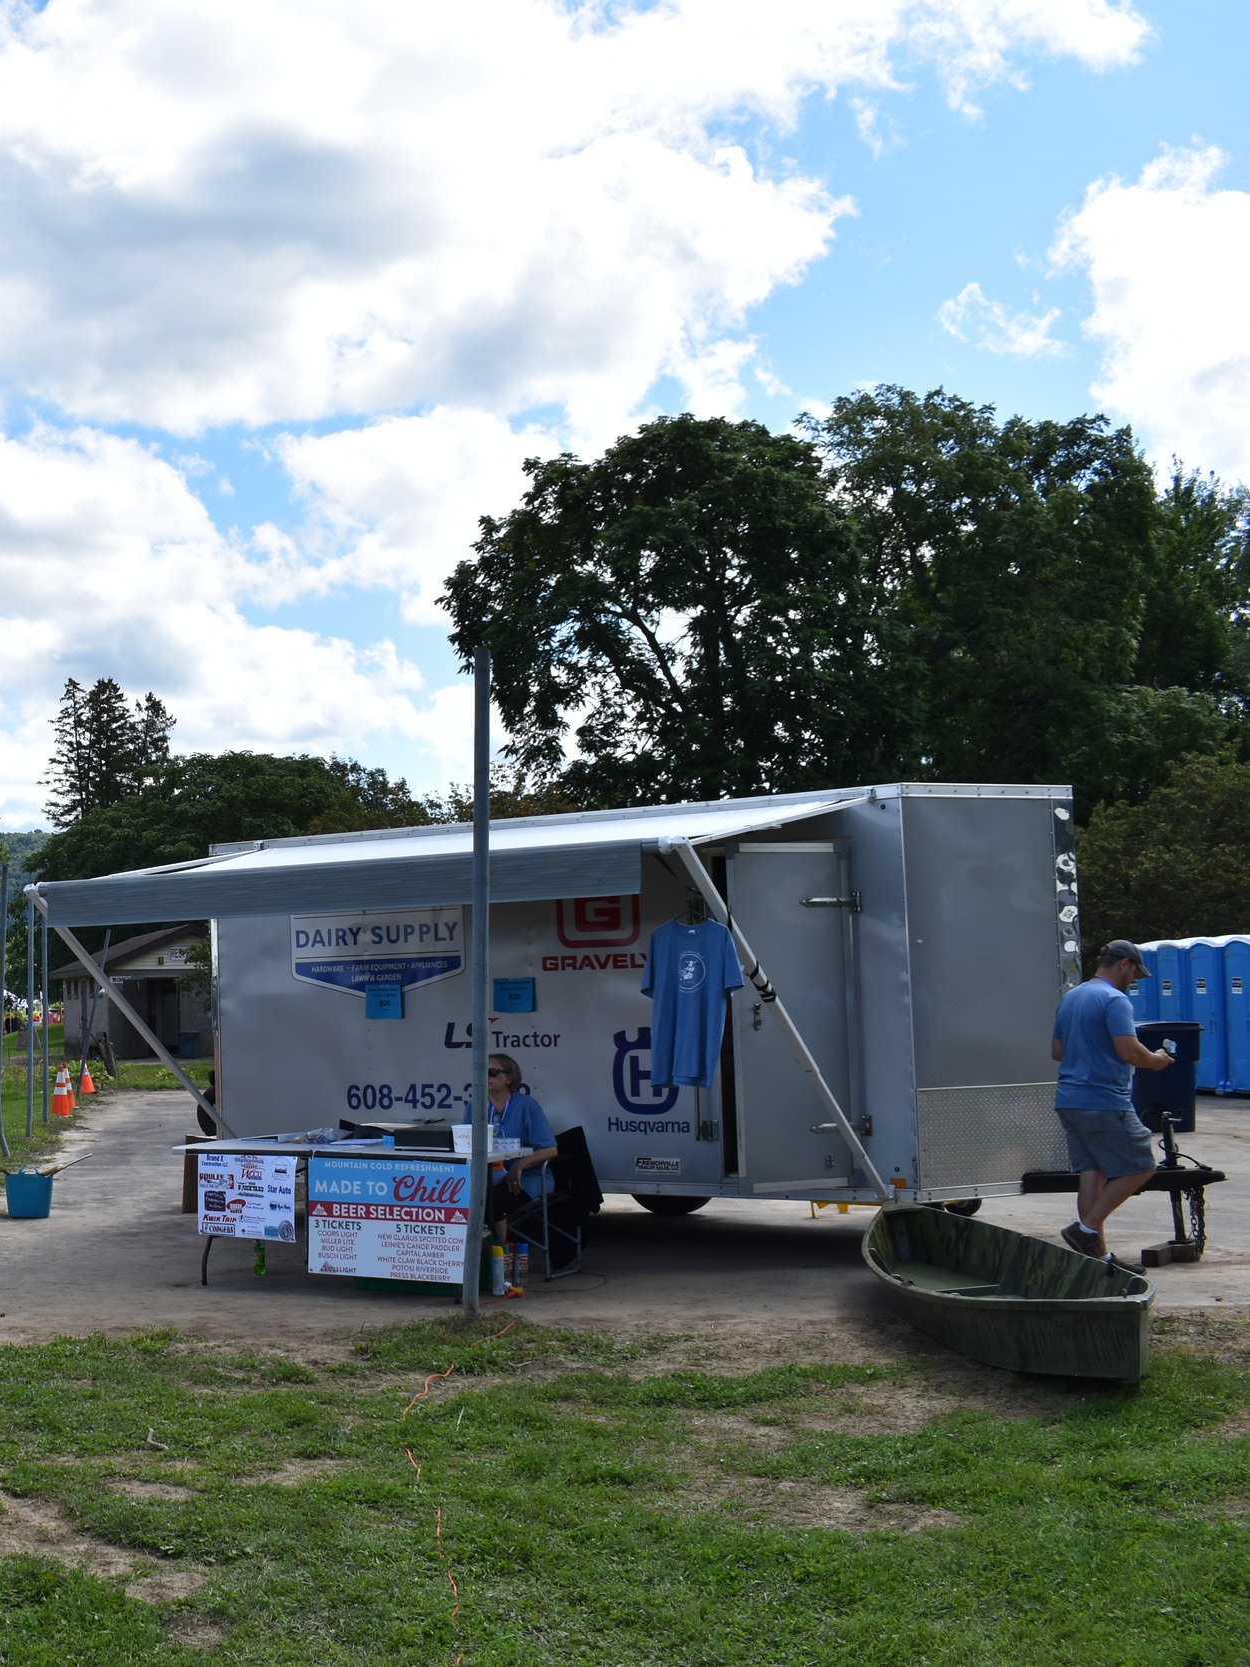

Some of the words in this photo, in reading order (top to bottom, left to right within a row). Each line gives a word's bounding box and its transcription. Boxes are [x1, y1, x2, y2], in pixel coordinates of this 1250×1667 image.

[295, 926, 363, 949] DAIRY
[370, 921, 459, 945] SUPPLY
[311, 965, 344, 973] HARDWARE
[351, 964, 370, 972] FARM
[370, 962, 406, 971] EQUIPMENT
[410, 960, 448, 969] APPLIANCES
[351, 975, 370, 983] LAWN
[376, 974, 402, 982] GARDEN
[491, 1031, 561, 1048] Tractor
[608, 1117, 690, 1135] Husqvarna
[324, 1161, 368, 1170] MOUNTAIN
[370, 1162, 393, 1170] COLD
[395, 1163, 455, 1173] REFRESHMENT
[636, 1157, 679, 1167] FRENCHVILLE
[267, 1184, 278, 1193] Star
[278, 1185, 291, 1194] Auto
[314, 1179, 362, 1195] MADE
[366, 1181, 388, 1196] TO
[392, 1175, 466, 1204] Chill
[332, 1203, 366, 1218] BEER
[369, 1205, 445, 1221] SELECTION
[202, 1213, 221, 1222] KWIK
[221, 1214, 237, 1223] TRIP
[314, 1219, 320, 1229] 3
[322, 1220, 362, 1231] TICKETS
[396, 1224, 402, 1233] 5
[404, 1224, 446, 1235] TICKETS
[393, 1234, 418, 1242] GLARUS
[381, 1241, 406, 1249] LEINIE'S
[430, 1244, 460, 1252] PADDLER
[417, 1258, 438, 1266] BLACK
[438, 1259, 465, 1267] CHERRY
[392, 1264, 415, 1272] POTOSI
[415, 1266, 449, 1274] RIVERSIDE
[410, 1273, 451, 1281] BLACKBERRY
